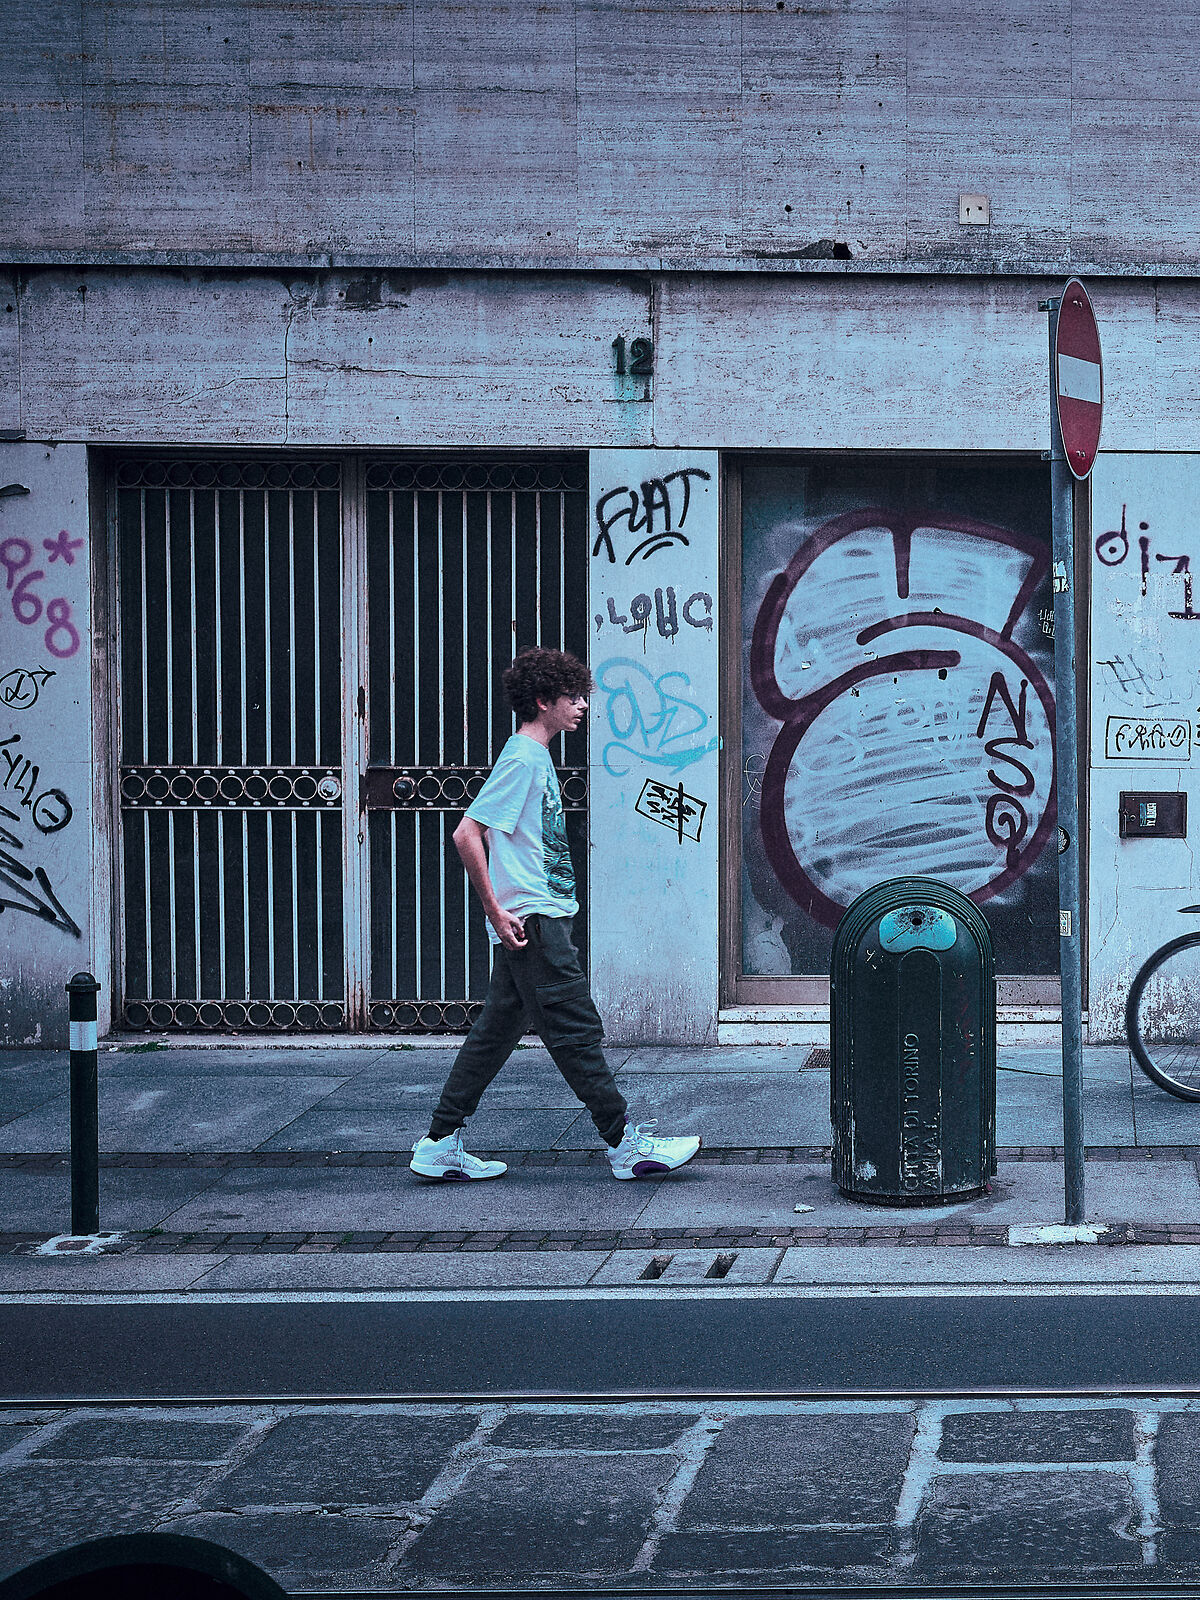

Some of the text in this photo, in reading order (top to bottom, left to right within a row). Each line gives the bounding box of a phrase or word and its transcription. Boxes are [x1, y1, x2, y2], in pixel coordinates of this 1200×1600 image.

[611, 334, 655, 375] 12
[903, 1033, 919, 1103] TORINO
[903, 1110, 919, 1128] DI
